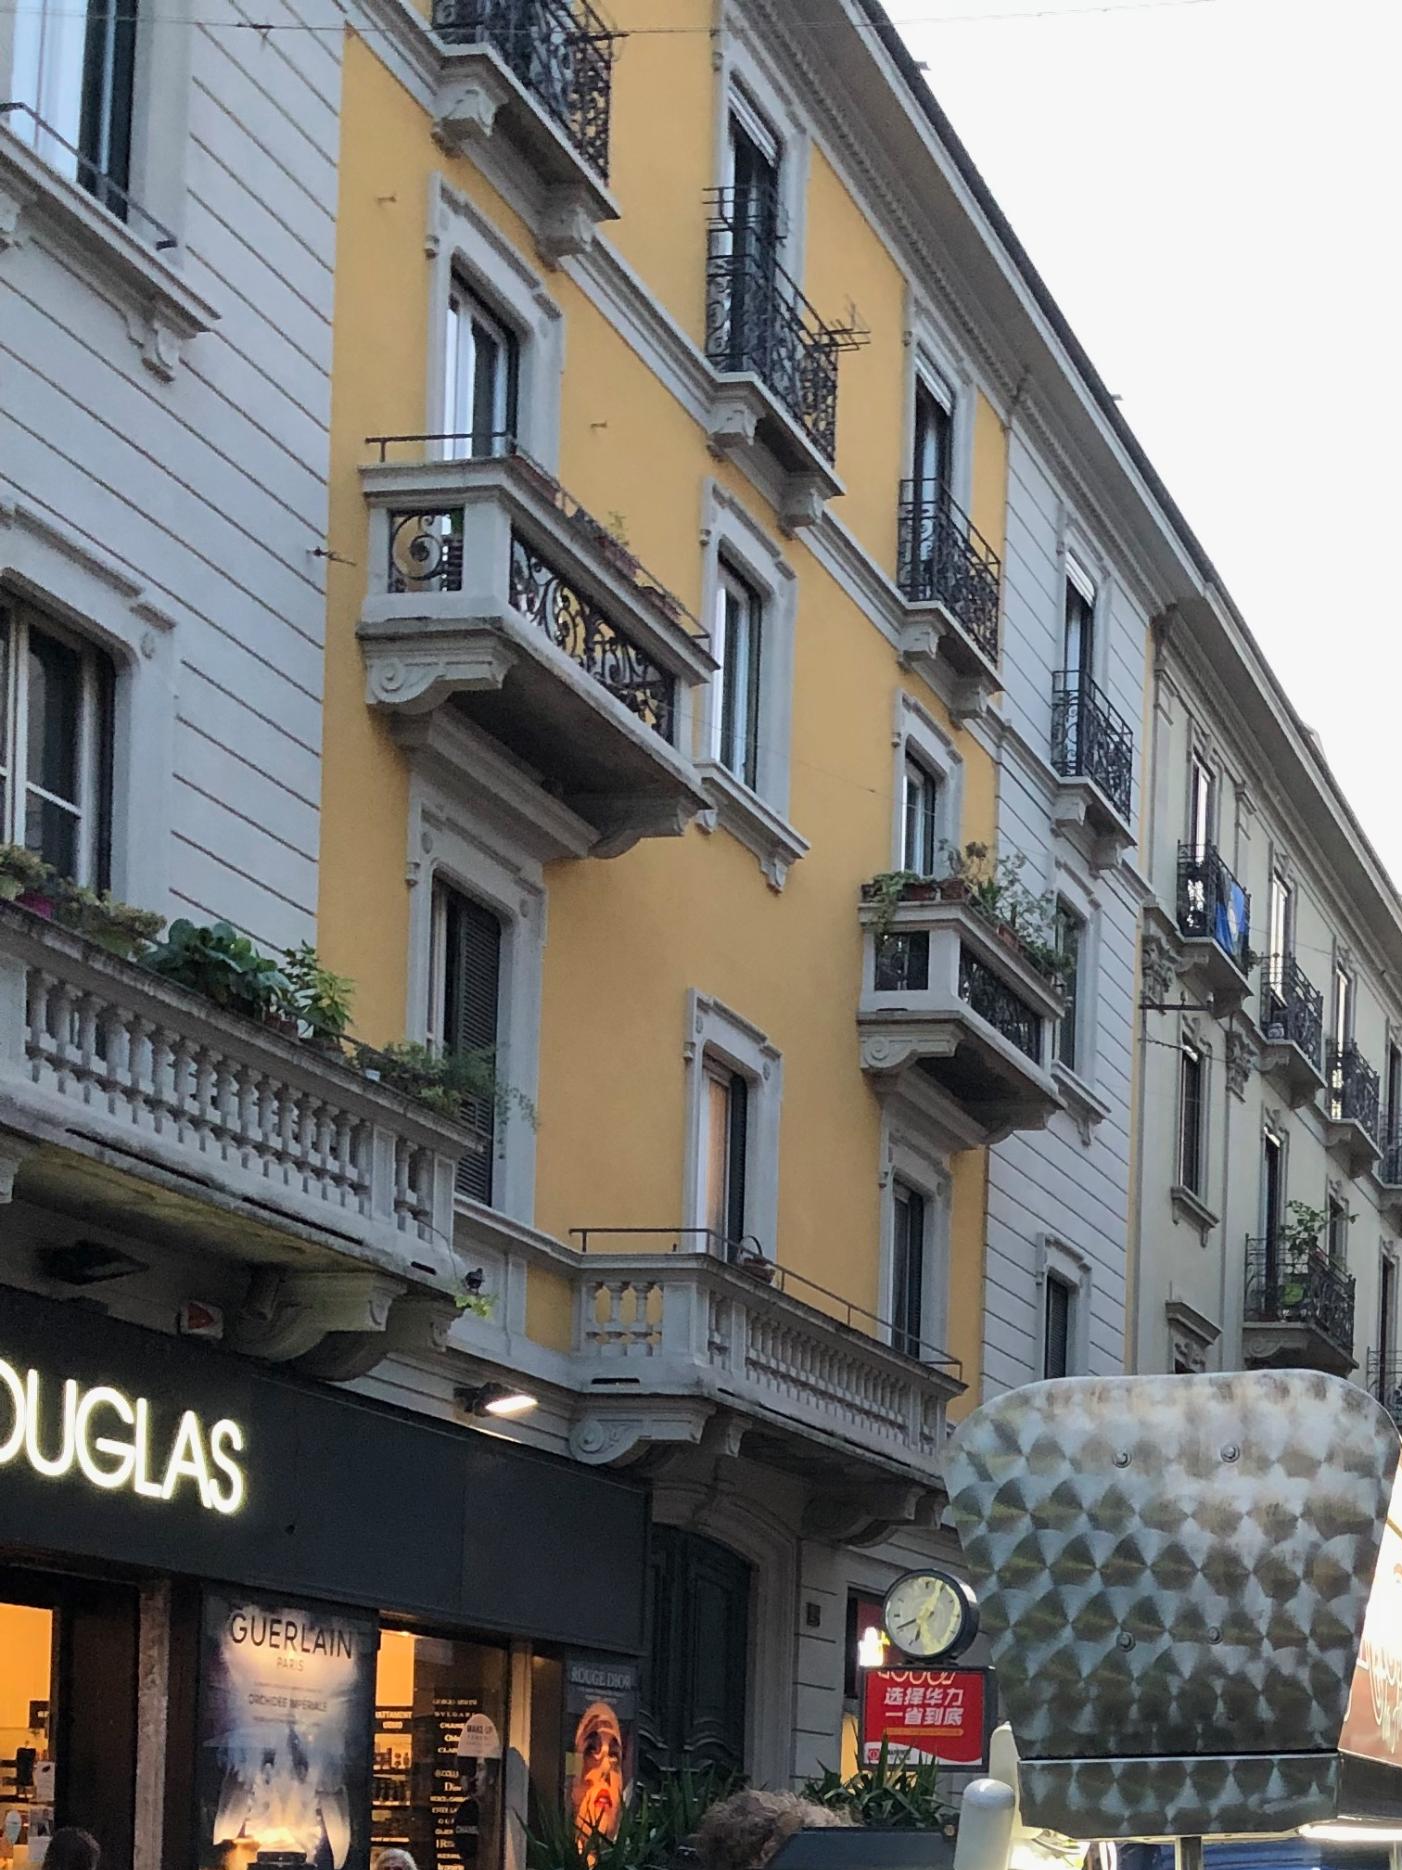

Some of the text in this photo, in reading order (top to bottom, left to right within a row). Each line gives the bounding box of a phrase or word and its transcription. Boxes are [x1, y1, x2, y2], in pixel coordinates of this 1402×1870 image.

[230, 1613, 352, 1659] GUERLAIN
[276, 1656, 304, 1672] PARIS
[571, 1666, 631, 1690] ROUGE DIOR
[884, 1687, 964, 1706] 选择华力
[884, 1707, 964, 1726] 一省到底
